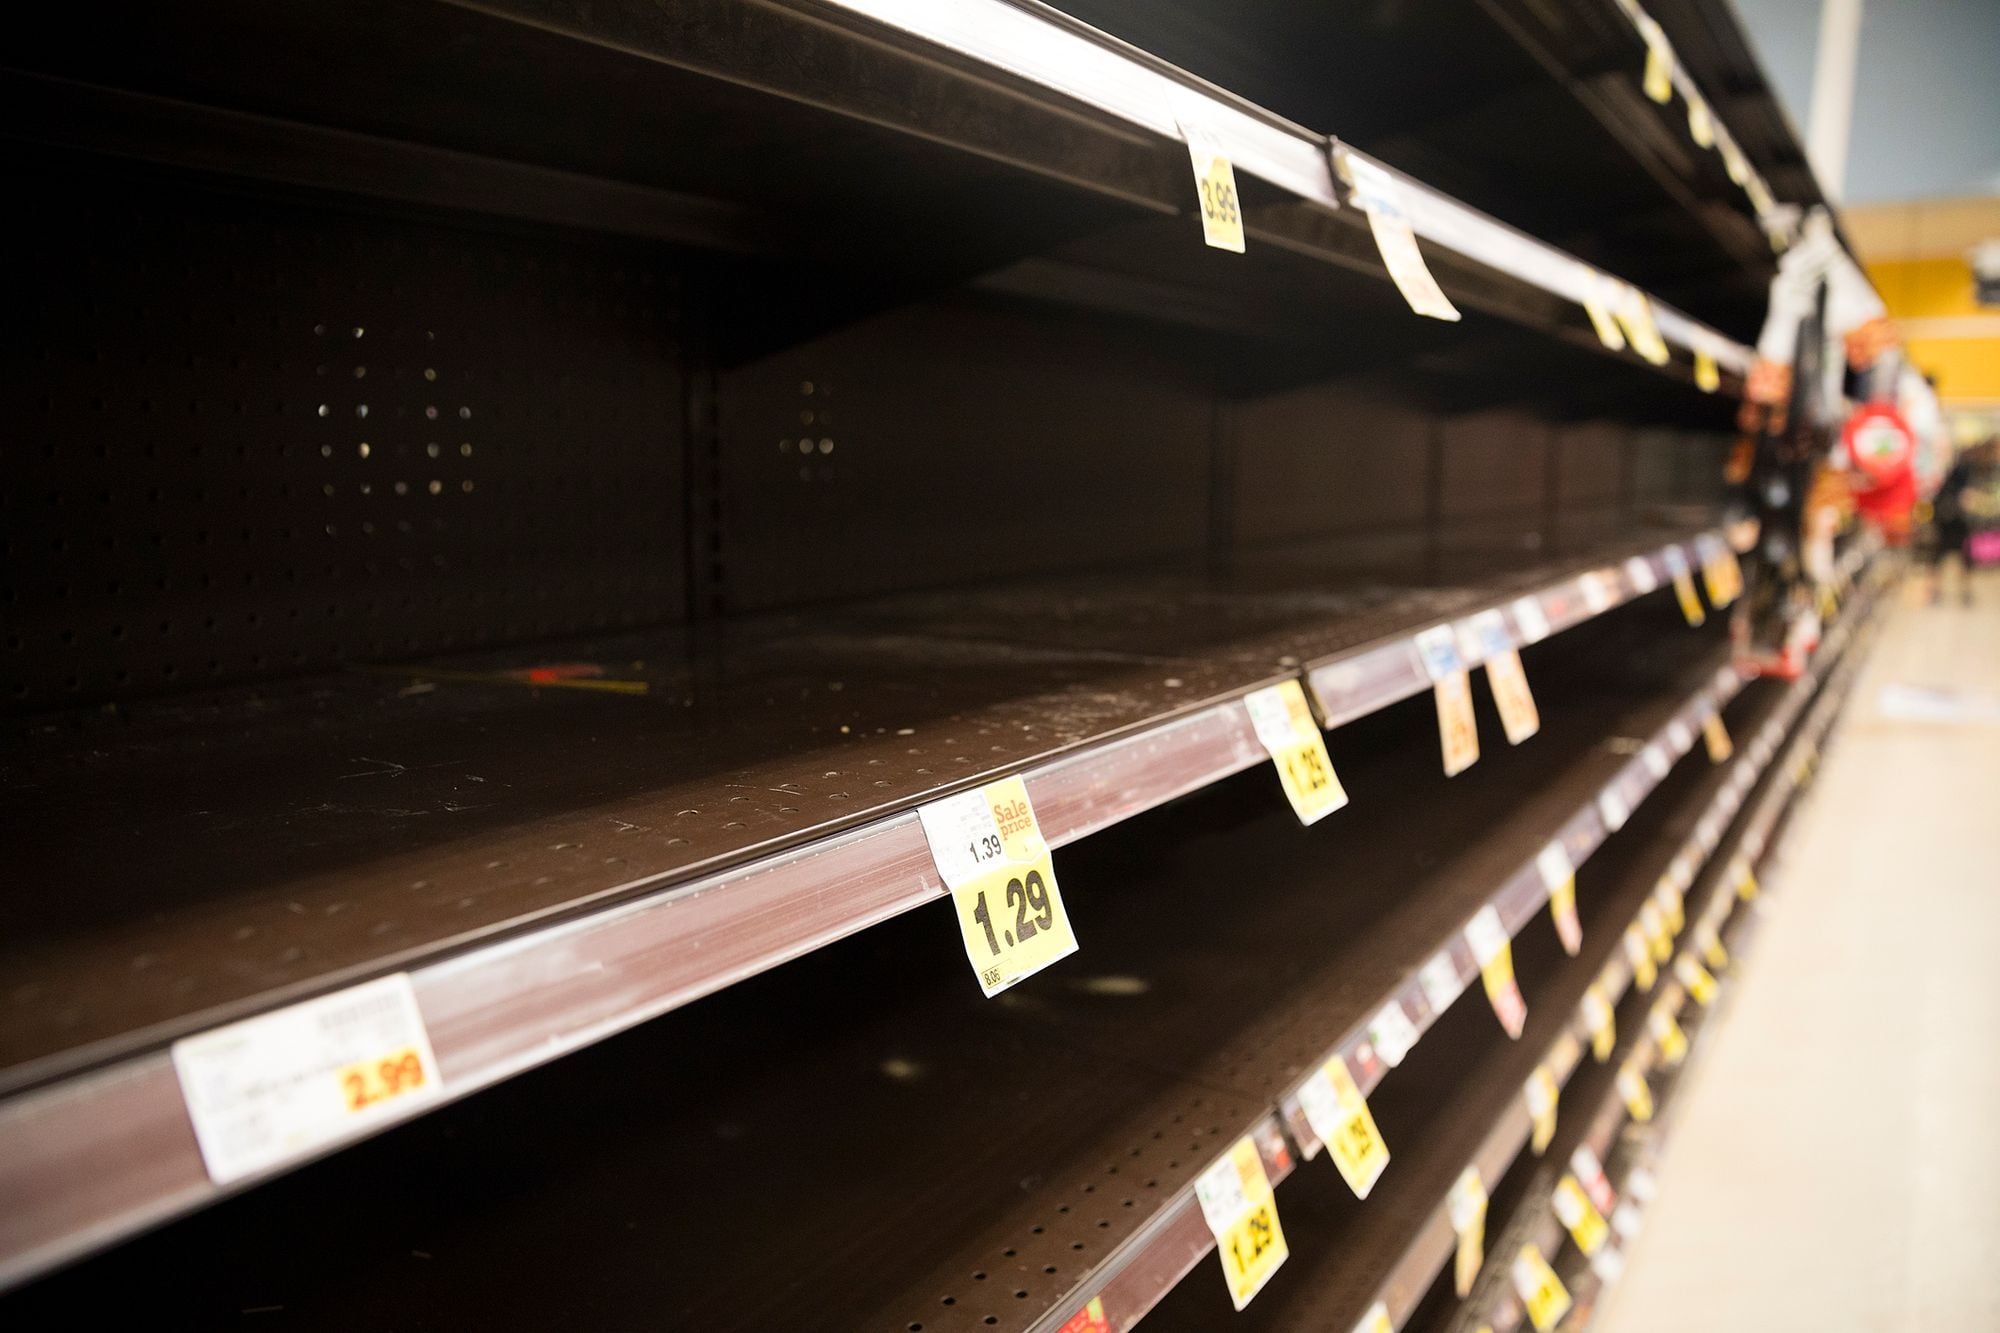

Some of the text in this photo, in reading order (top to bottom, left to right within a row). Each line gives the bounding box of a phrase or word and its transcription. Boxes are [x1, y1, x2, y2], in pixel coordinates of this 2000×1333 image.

[1201, 178, 1237, 225] 3.99
[993, 799, 1029, 825] Sale
[1000, 816, 1033, 842] price
[969, 834, 1003, 863] 1.39
[973, 869, 1053, 956] 1.29
[343, 1051, 428, 1111] 2.99
